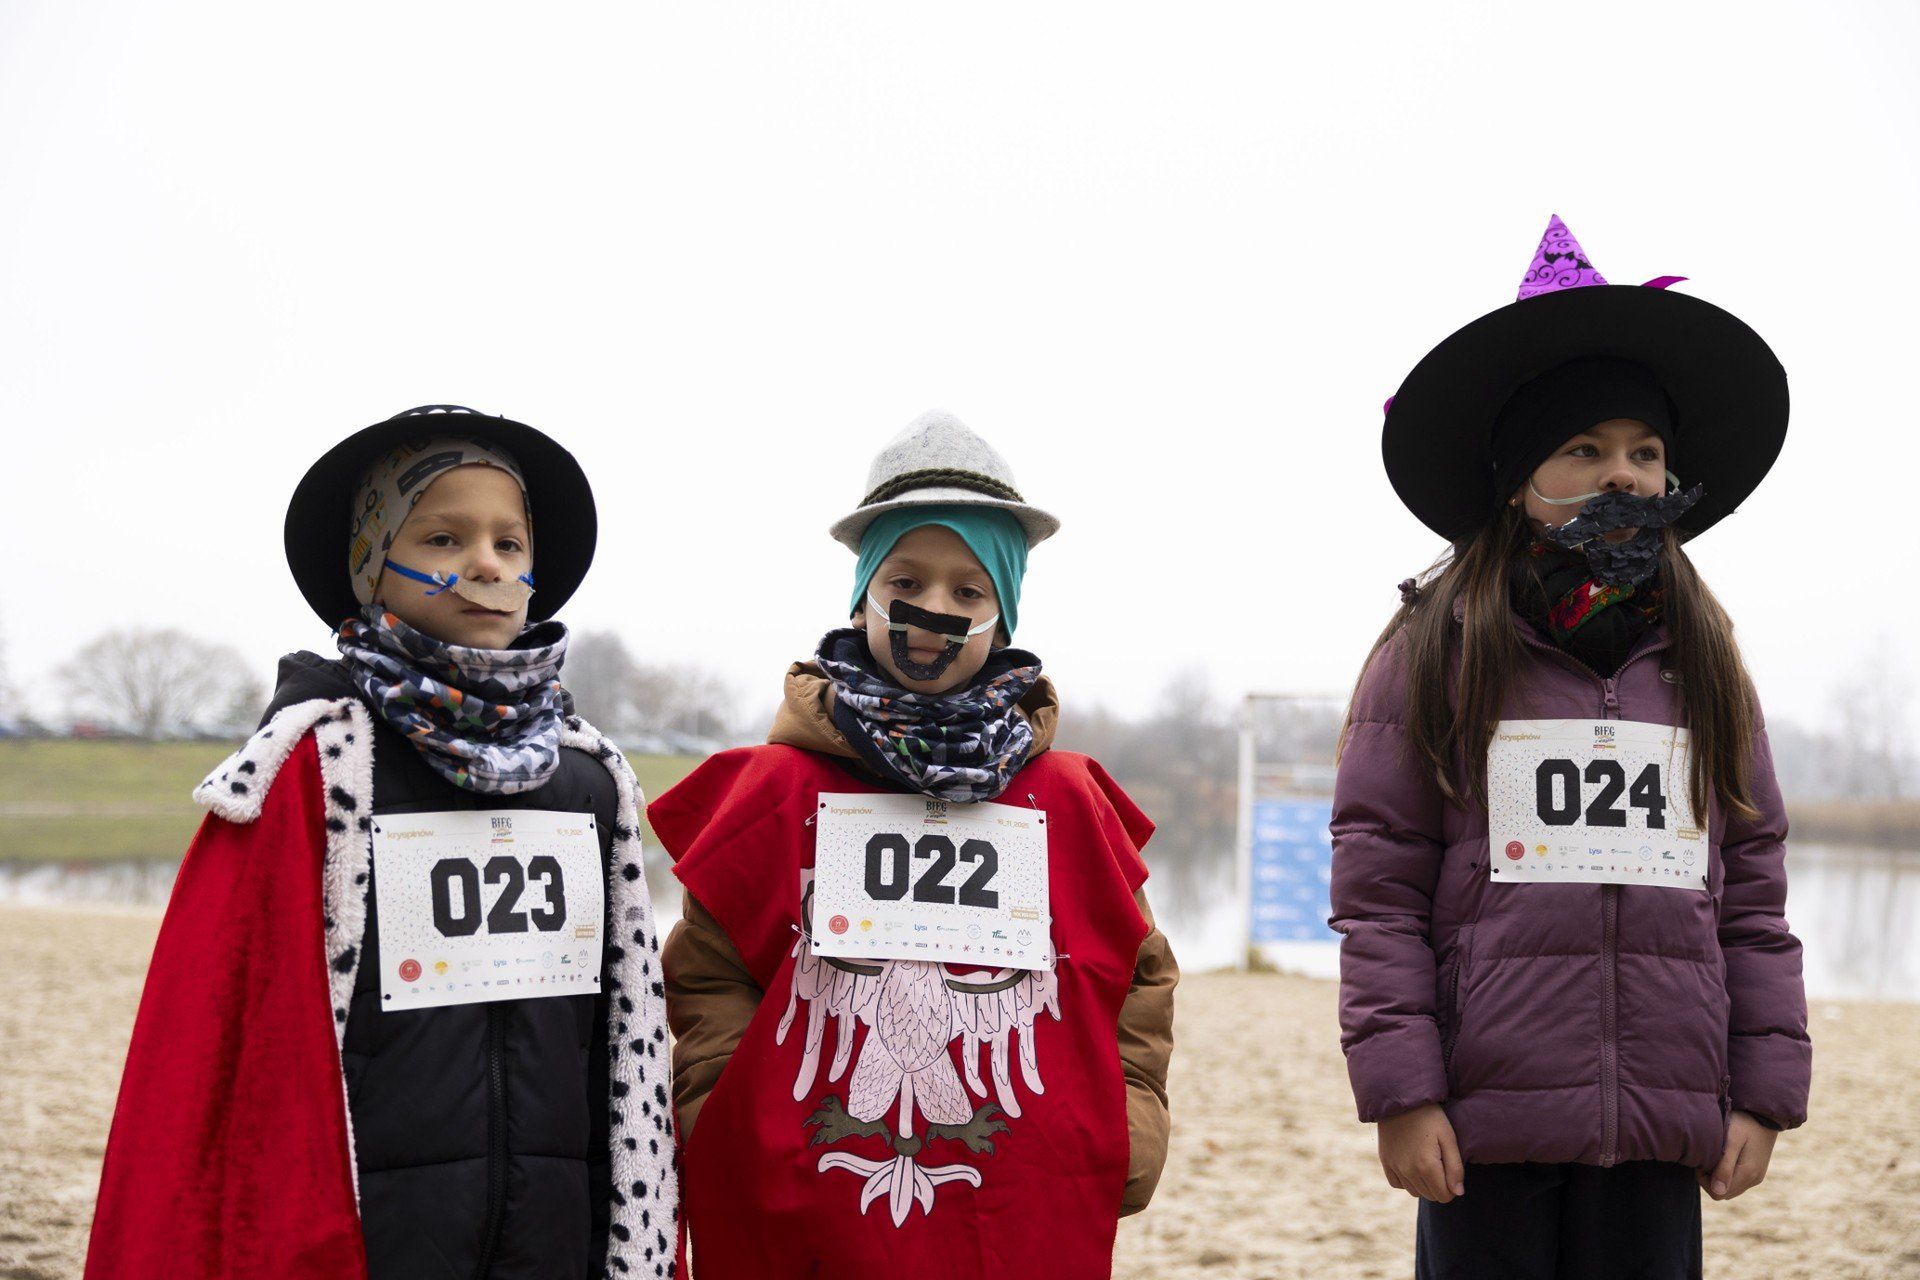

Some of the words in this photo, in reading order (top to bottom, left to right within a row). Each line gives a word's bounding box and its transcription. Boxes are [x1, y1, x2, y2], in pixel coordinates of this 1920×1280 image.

[1594, 726, 1615, 737] BIEG
[1499, 733, 1541, 743] kryspinów
[1535, 758, 1667, 830] 024
[830, 806, 873, 816] kryspinów
[926, 801, 947, 812] BIEG
[491, 817, 512, 829] BIEG
[863, 832, 999, 910] 022
[430, 855, 567, 938] 023
